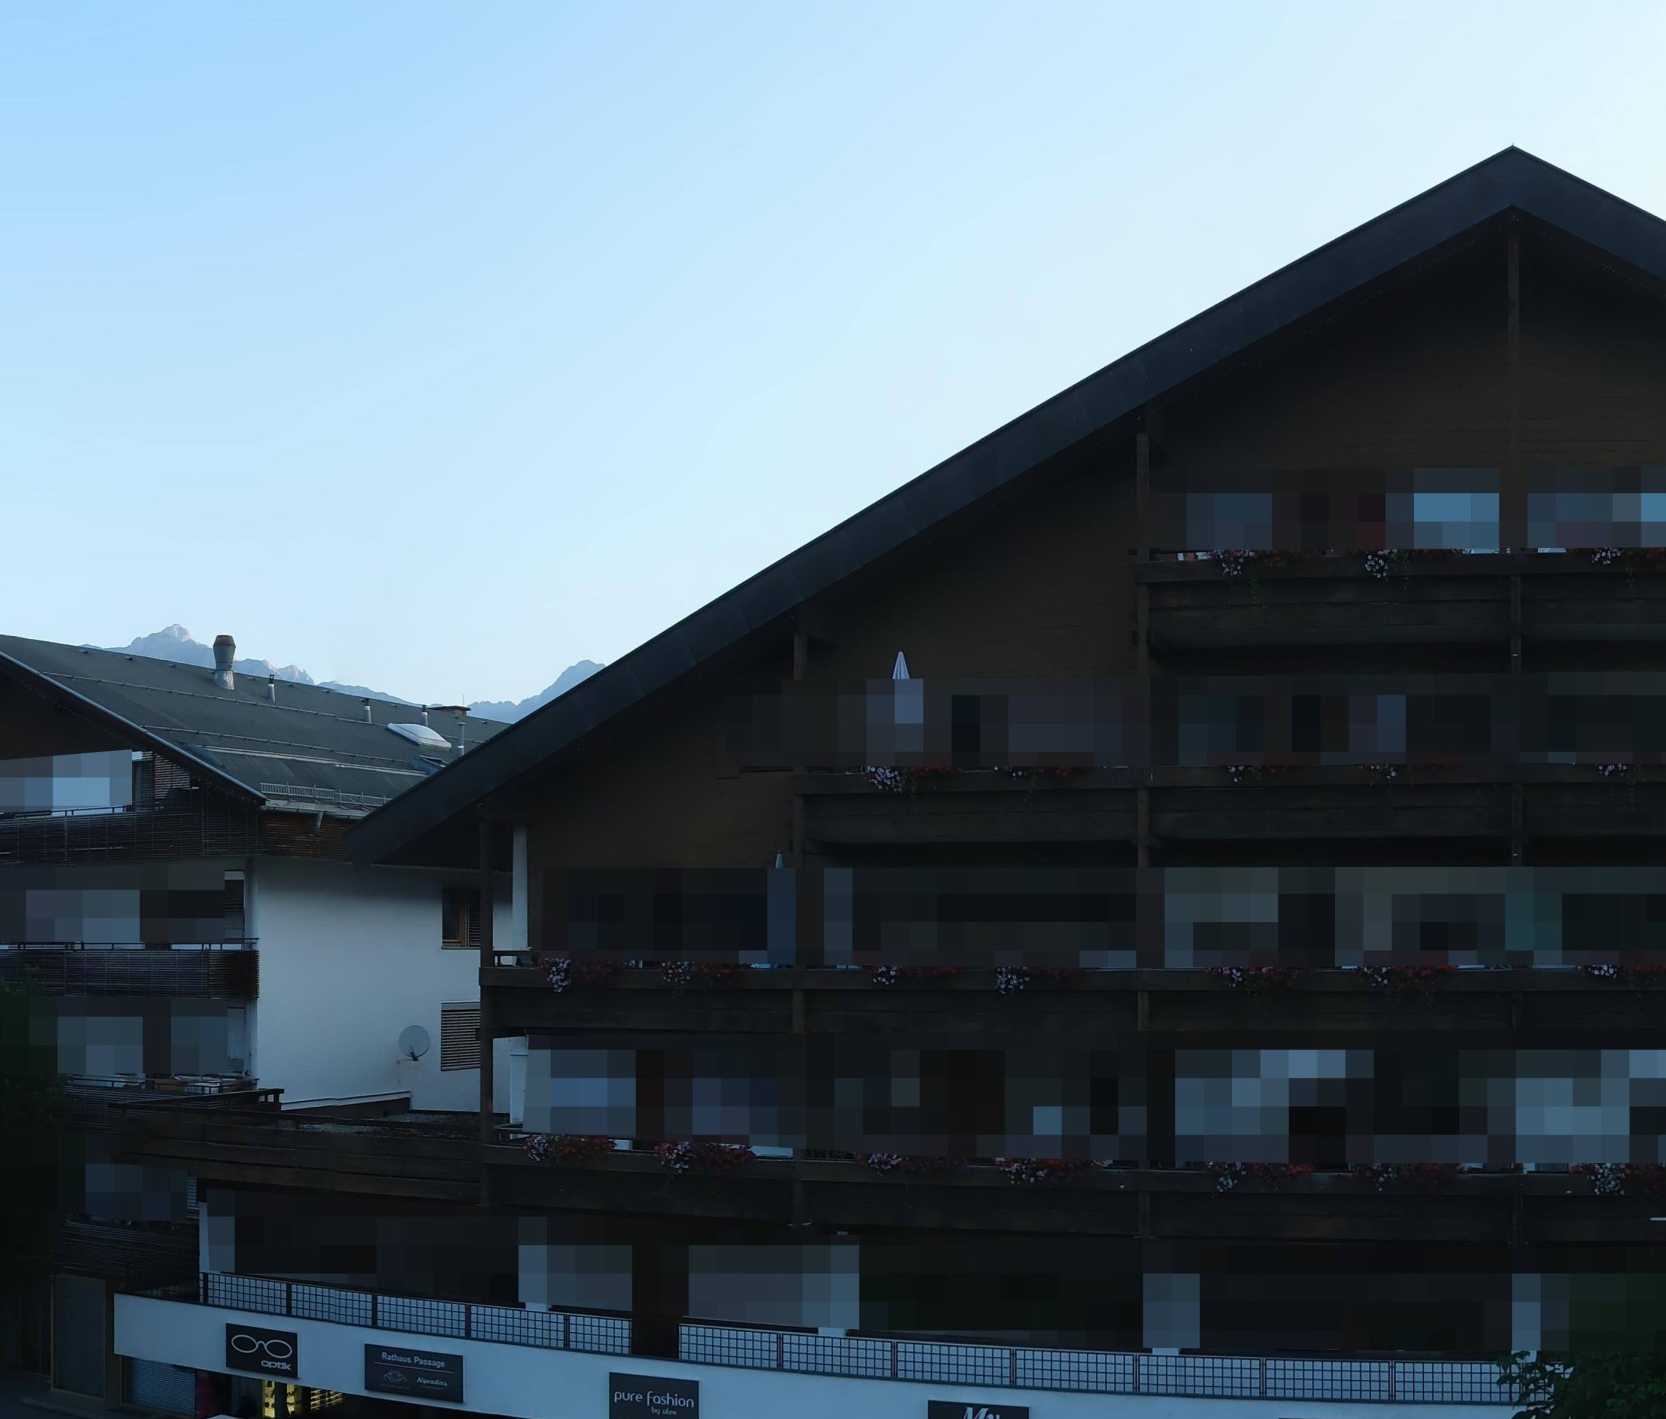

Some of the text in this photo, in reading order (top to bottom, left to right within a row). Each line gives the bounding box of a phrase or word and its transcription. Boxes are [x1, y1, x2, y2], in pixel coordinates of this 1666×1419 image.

[261, 1359, 292, 1372] optik
[381, 1351, 446, 1368] Rathaus Passage
[614, 1390, 695, 1408] pure fashion
